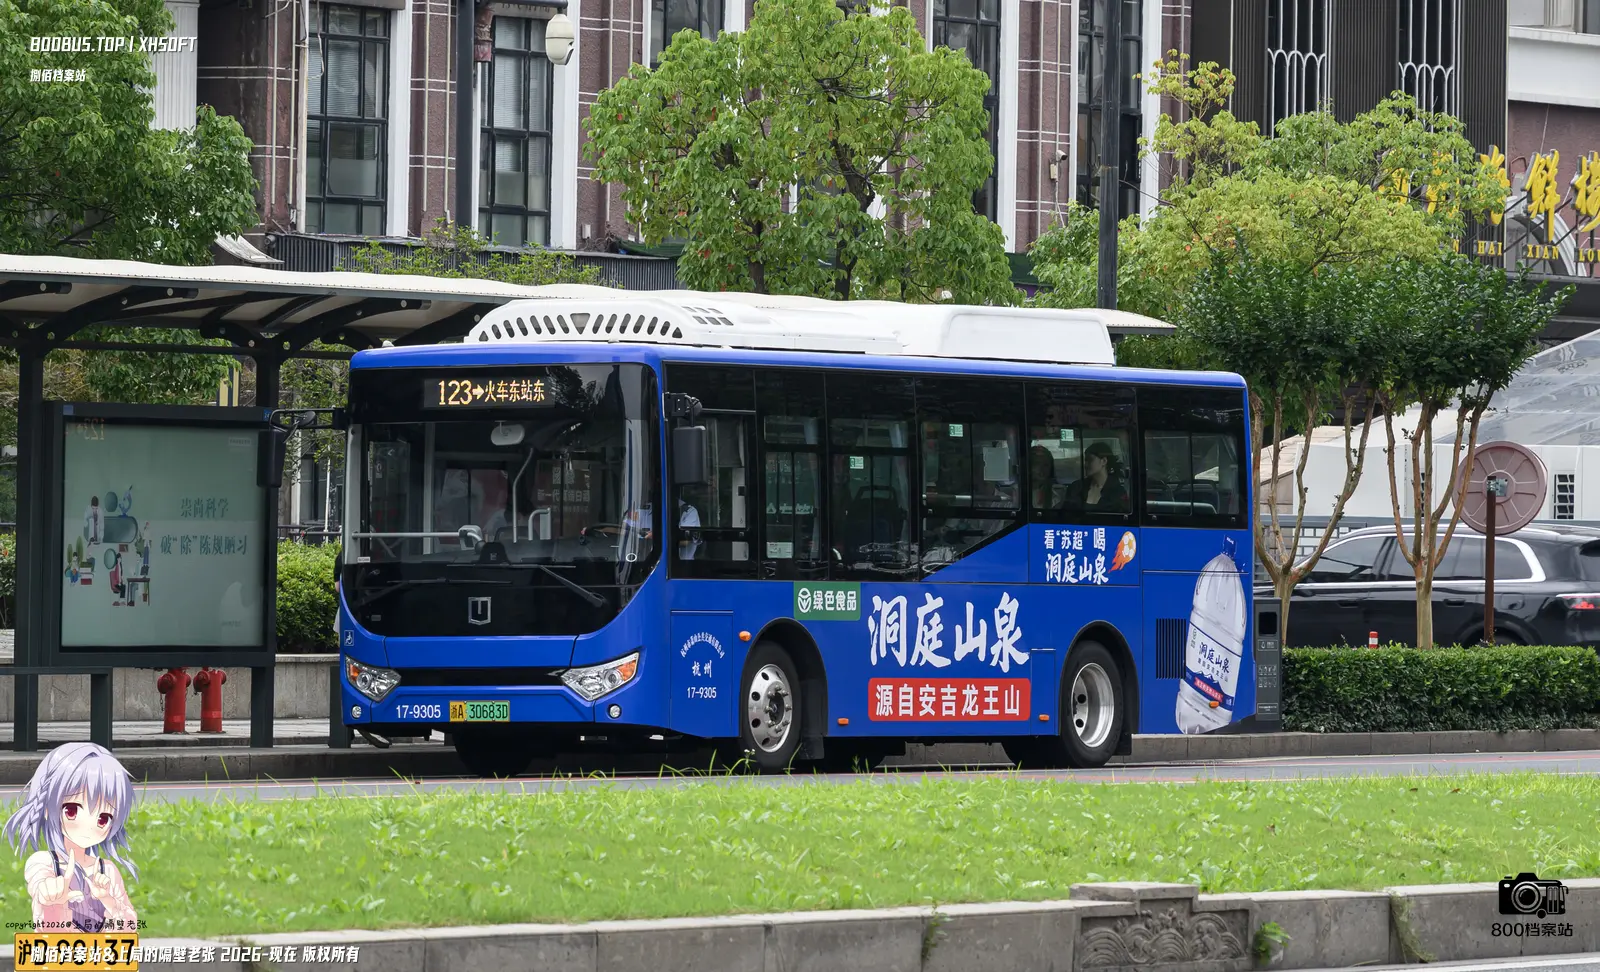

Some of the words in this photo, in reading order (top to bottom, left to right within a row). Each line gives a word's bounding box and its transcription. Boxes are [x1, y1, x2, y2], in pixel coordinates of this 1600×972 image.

[1477, 240, 1503, 255] HAI
[1527, 245, 1560, 260] XIAN
[438, 379, 473, 405] 123
[484, 379, 545, 403] 火车东站东
[180, 498, 229, 518] 崇尚科学
[1045, 552, 1109, 585] 洞庭山泉
[813, 590, 857, 611] 绿色食品
[867, 591, 1030, 673] 洞庭山泉
[1198, 641, 1230, 674] 洞庭山泉
[691, 659, 713, 679] 杭州
[686, 686, 717, 699] 17-9305
[875, 683, 1020, 717] 源自安吉龙王山
[395, 704, 441, 719] 17-9305
[469, 704, 508, 719] 30683D
